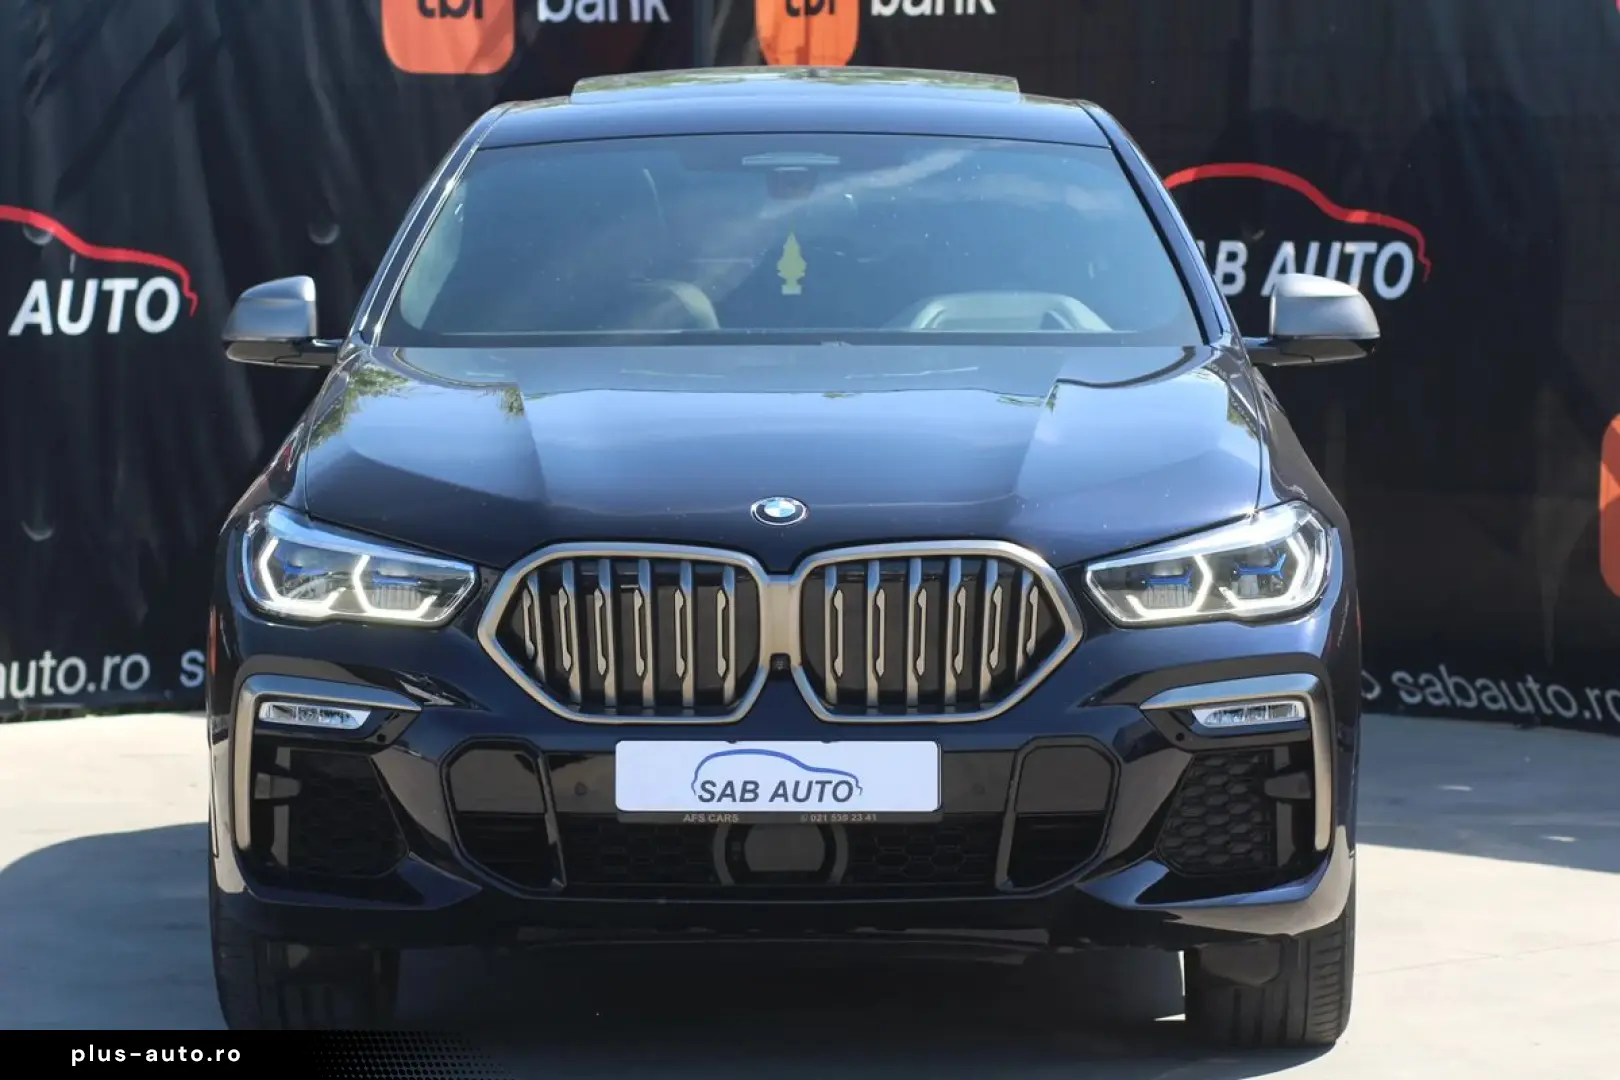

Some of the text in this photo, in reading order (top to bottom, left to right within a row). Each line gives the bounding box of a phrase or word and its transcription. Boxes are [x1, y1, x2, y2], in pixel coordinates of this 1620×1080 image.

[1197, 240, 1415, 300] B AUTO
[8, 276, 181, 336] AUTO
[697, 779, 854, 803] SAB AUTO
[682, 813, 740, 823] AFS CARS
[810, 813, 828, 823] 021
[851, 813, 863, 823] 23
[864, 813, 877, 823] 41
